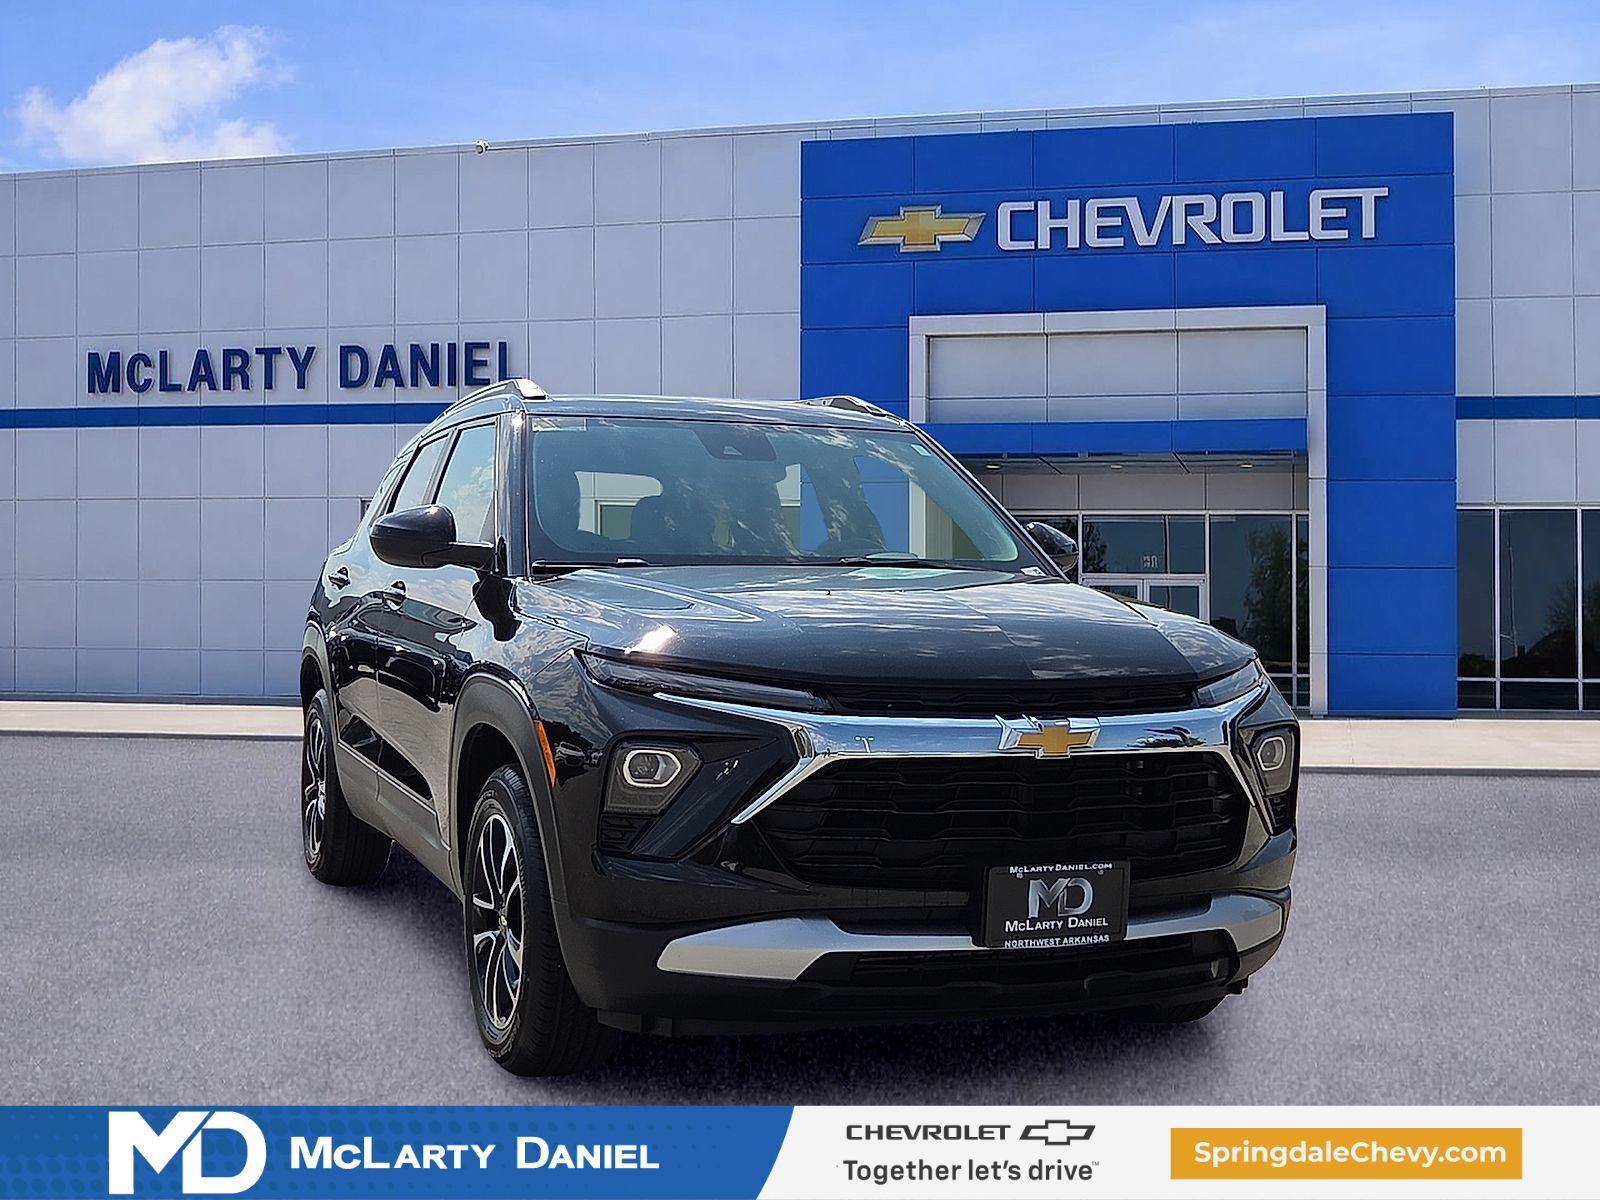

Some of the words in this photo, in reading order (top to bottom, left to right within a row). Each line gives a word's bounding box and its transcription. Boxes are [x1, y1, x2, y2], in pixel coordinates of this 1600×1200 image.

[997, 187, 1388, 250] CHEVROLET
[339, 341, 522, 388] DANIEL
[1028, 877, 1093, 918] MD
[1004, 938, 1061, 948] NORTHWEST
[1063, 934, 1109, 944] ARKANSAS
